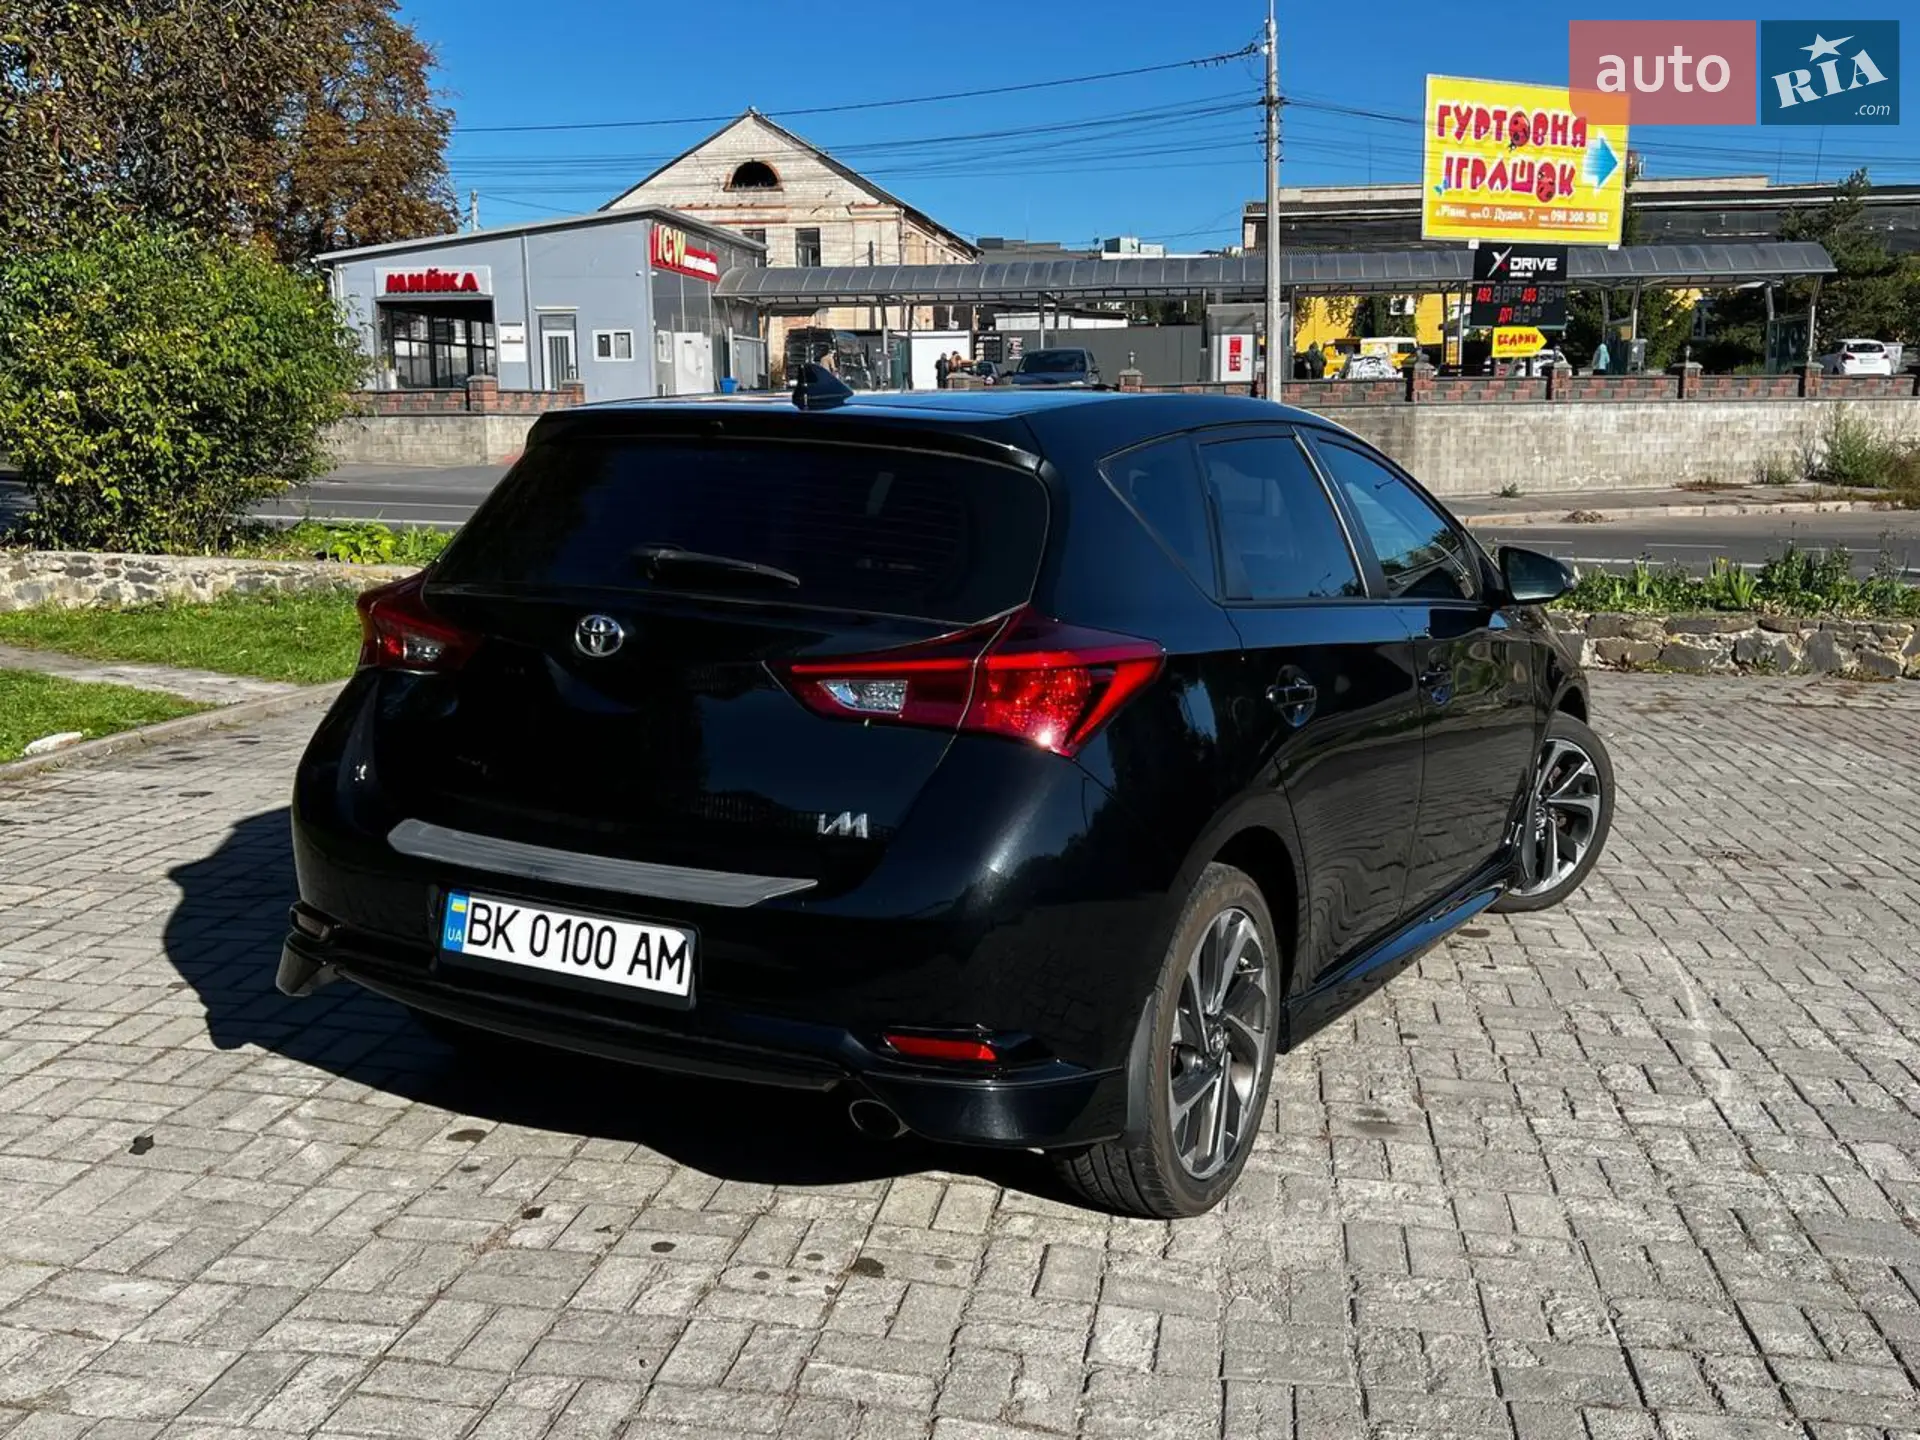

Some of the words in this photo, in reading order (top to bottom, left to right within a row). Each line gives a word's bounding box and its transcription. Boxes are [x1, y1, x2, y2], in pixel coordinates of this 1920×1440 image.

[1436, 103, 1588, 150] ГУРТОВНЯ
[1443, 156, 1577, 203] ІГРАШОК
[386, 268, 479, 293] МИЙКА
[1510, 257, 1558, 271] DRIVE
[447, 927, 462, 943] UA
[467, 902, 521, 954] BK
[529, 914, 617, 970] 0100
[627, 932, 687, 985] AM
